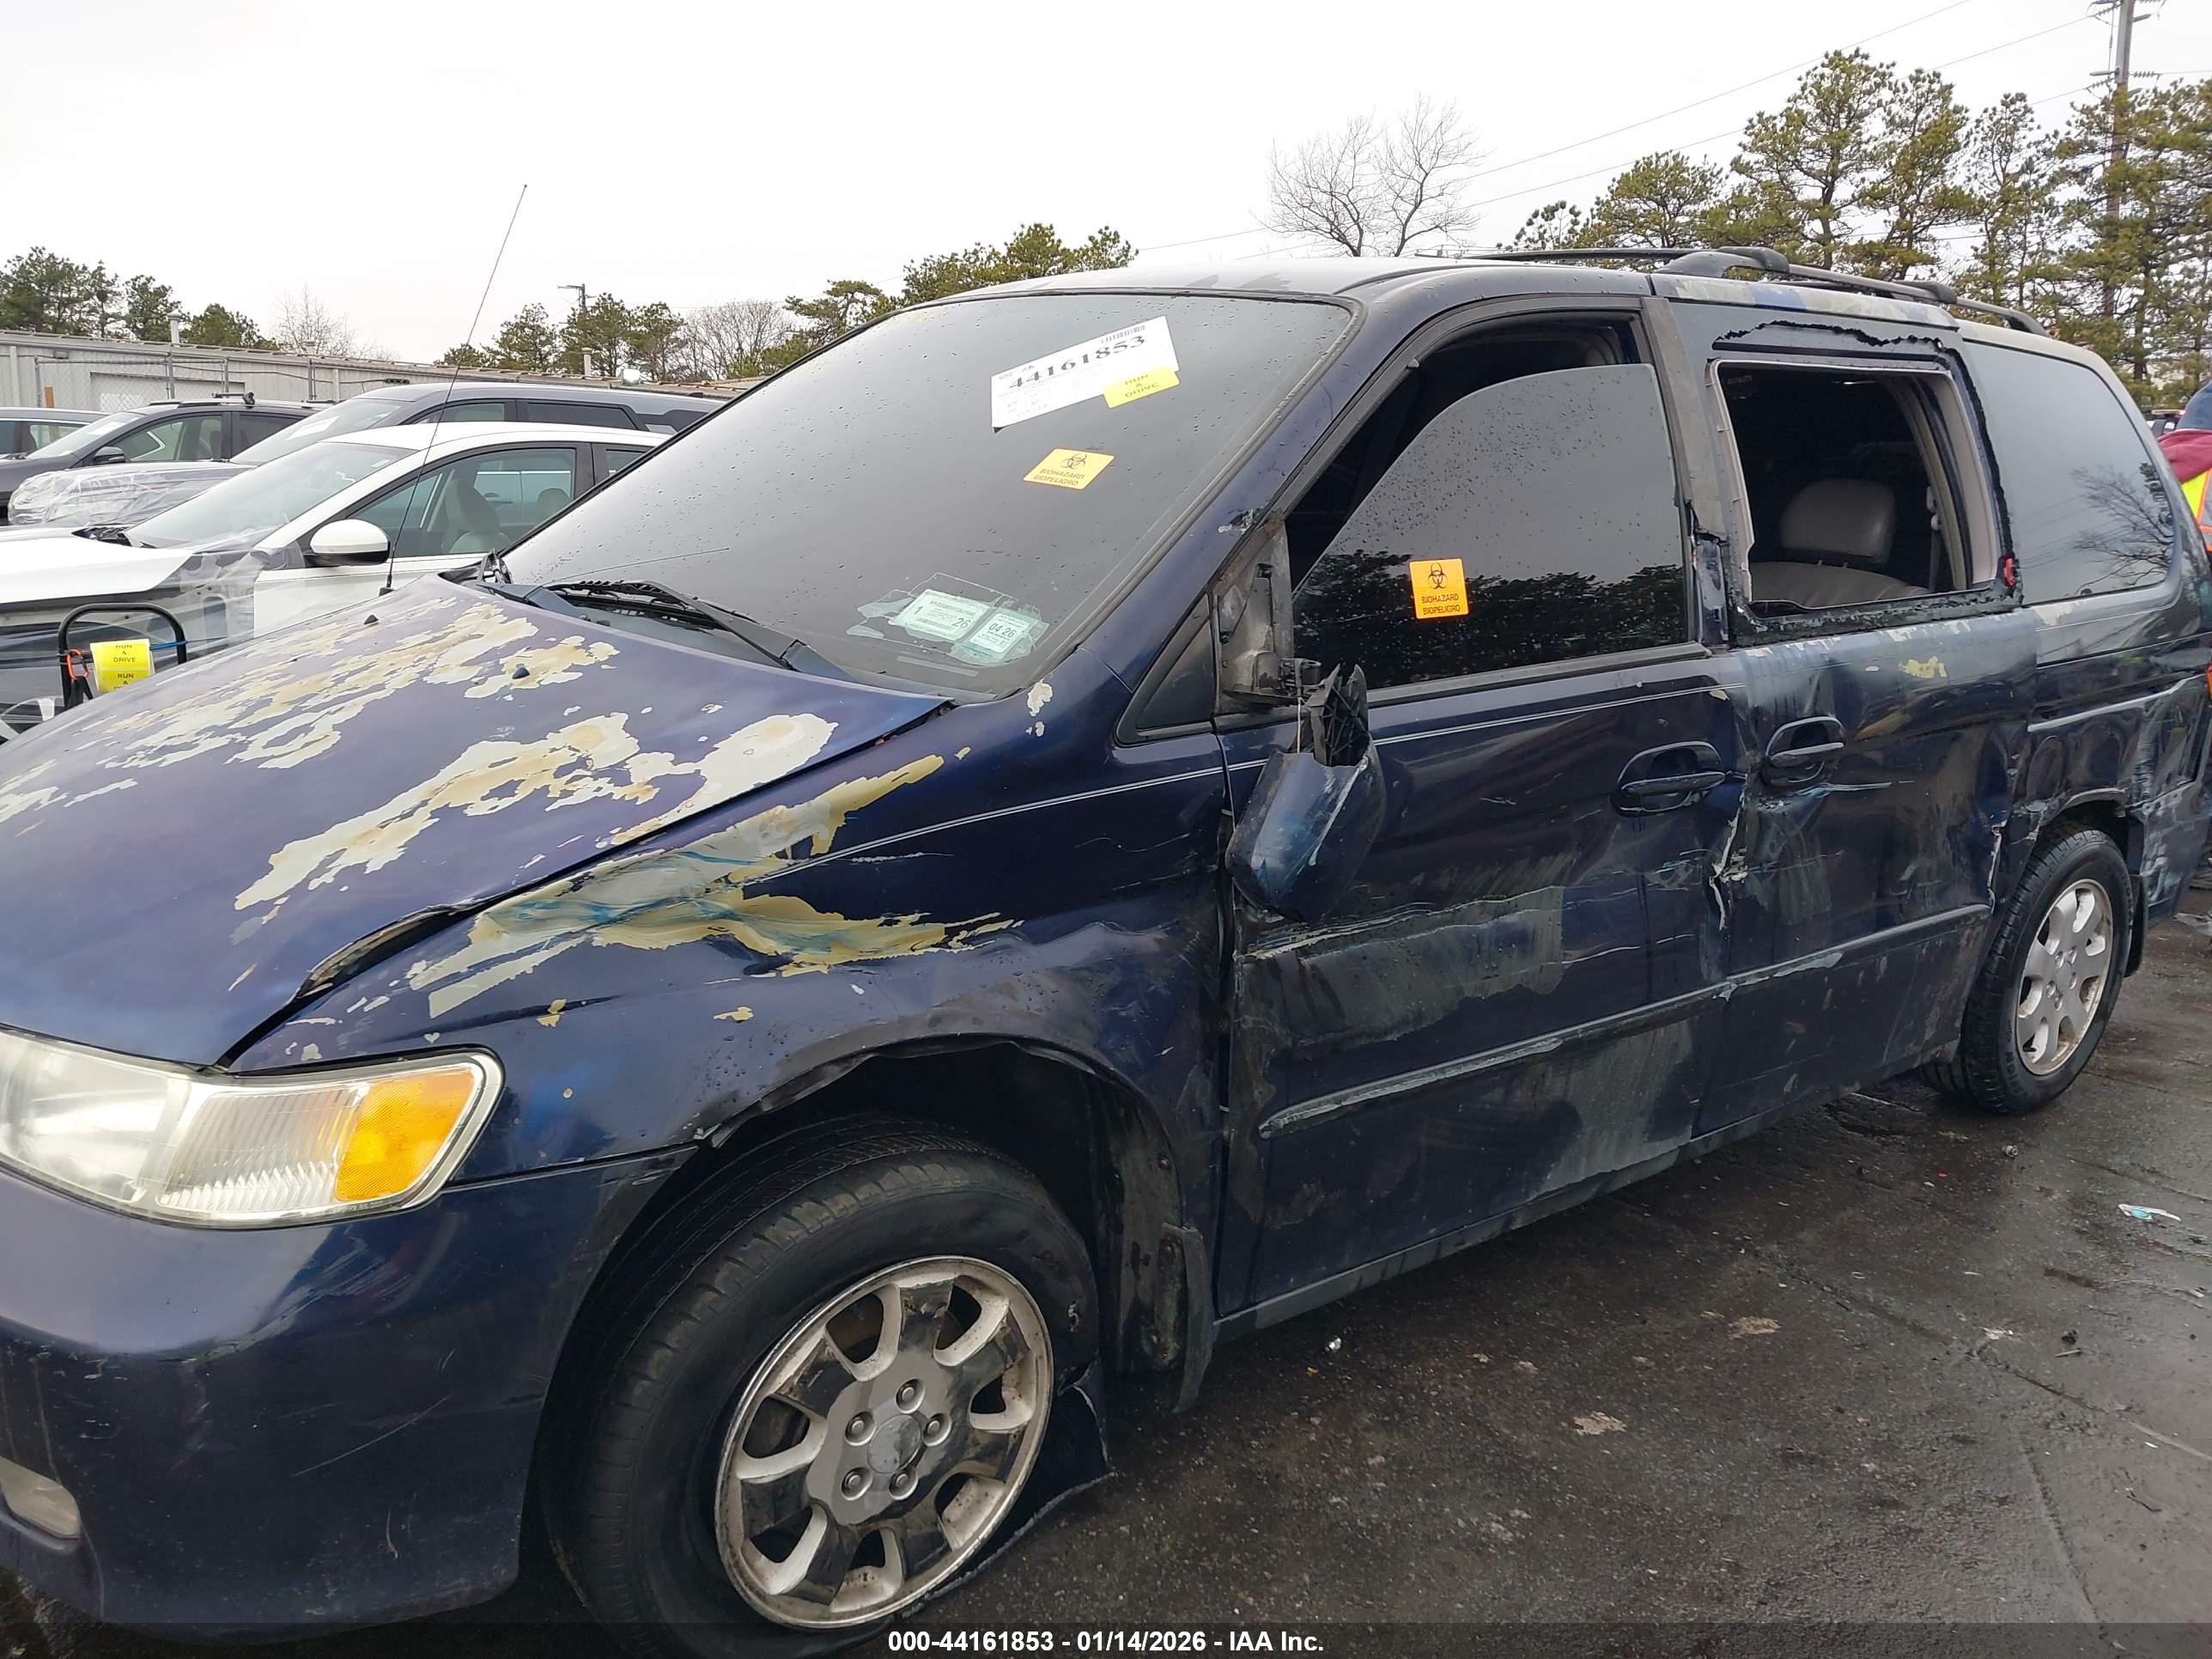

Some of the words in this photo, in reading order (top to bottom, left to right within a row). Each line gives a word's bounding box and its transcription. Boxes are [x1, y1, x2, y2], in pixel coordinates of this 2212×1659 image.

[1009, 336, 1145, 388] 44161853
[1039, 469, 1085, 479] BIOHAZARD
[1033, 475, 1079, 485] BIOPELIGRO
[1421, 593, 1459, 604] BIOHAZARD
[1422, 605, 1461, 615] BIOPELIGRO
[951, 617, 971, 628] 26
[988, 623, 1003, 632] 04
[1001, 627, 1017, 638] 26
